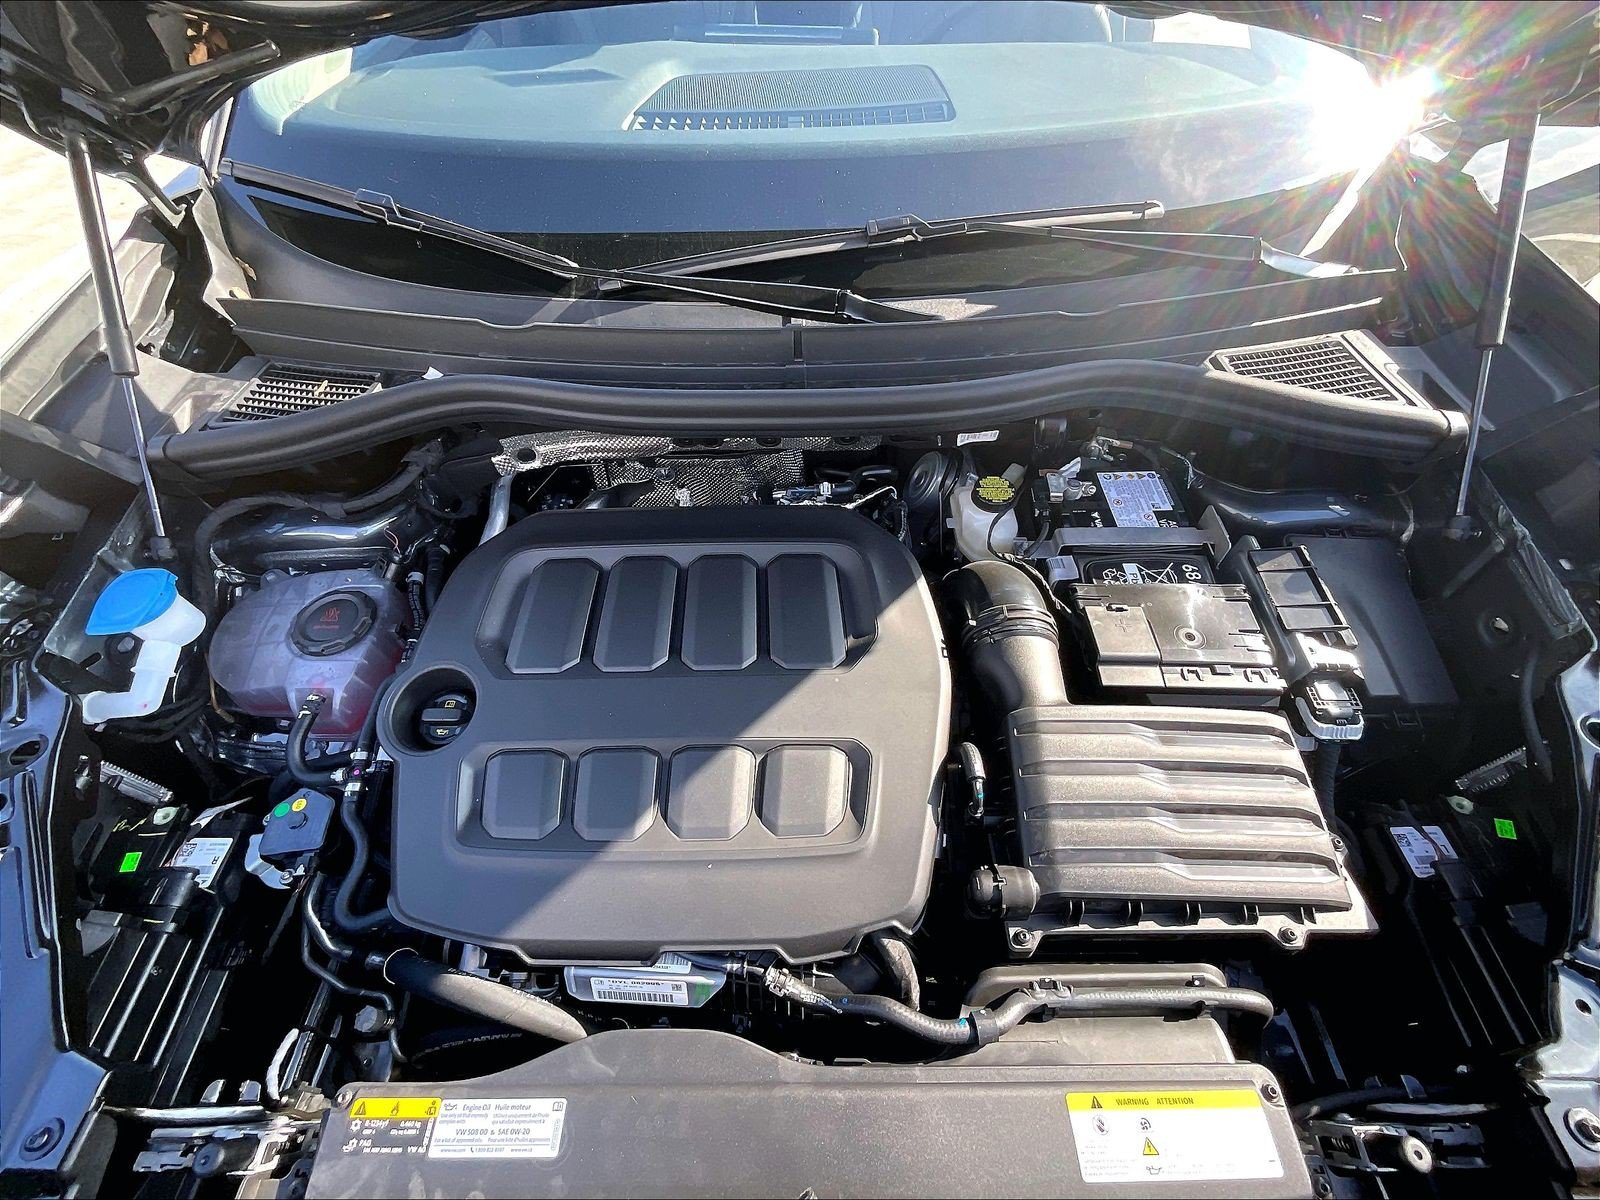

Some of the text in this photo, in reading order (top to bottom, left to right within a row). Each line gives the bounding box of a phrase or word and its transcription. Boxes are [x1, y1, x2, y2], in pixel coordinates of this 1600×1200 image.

[1115, 1097, 1194, 1106] WARNING ATTENTION
[462, 1103, 482, 1112] Engine
[494, 1103, 510, 1111] Huile
[510, 1103, 532, 1111] moteur
[456, 1128, 467, 1136] VW
[467, 1128, 480, 1136] 508
[480, 1128, 489, 1136] 00
[497, 1128, 510, 1136] SAE
